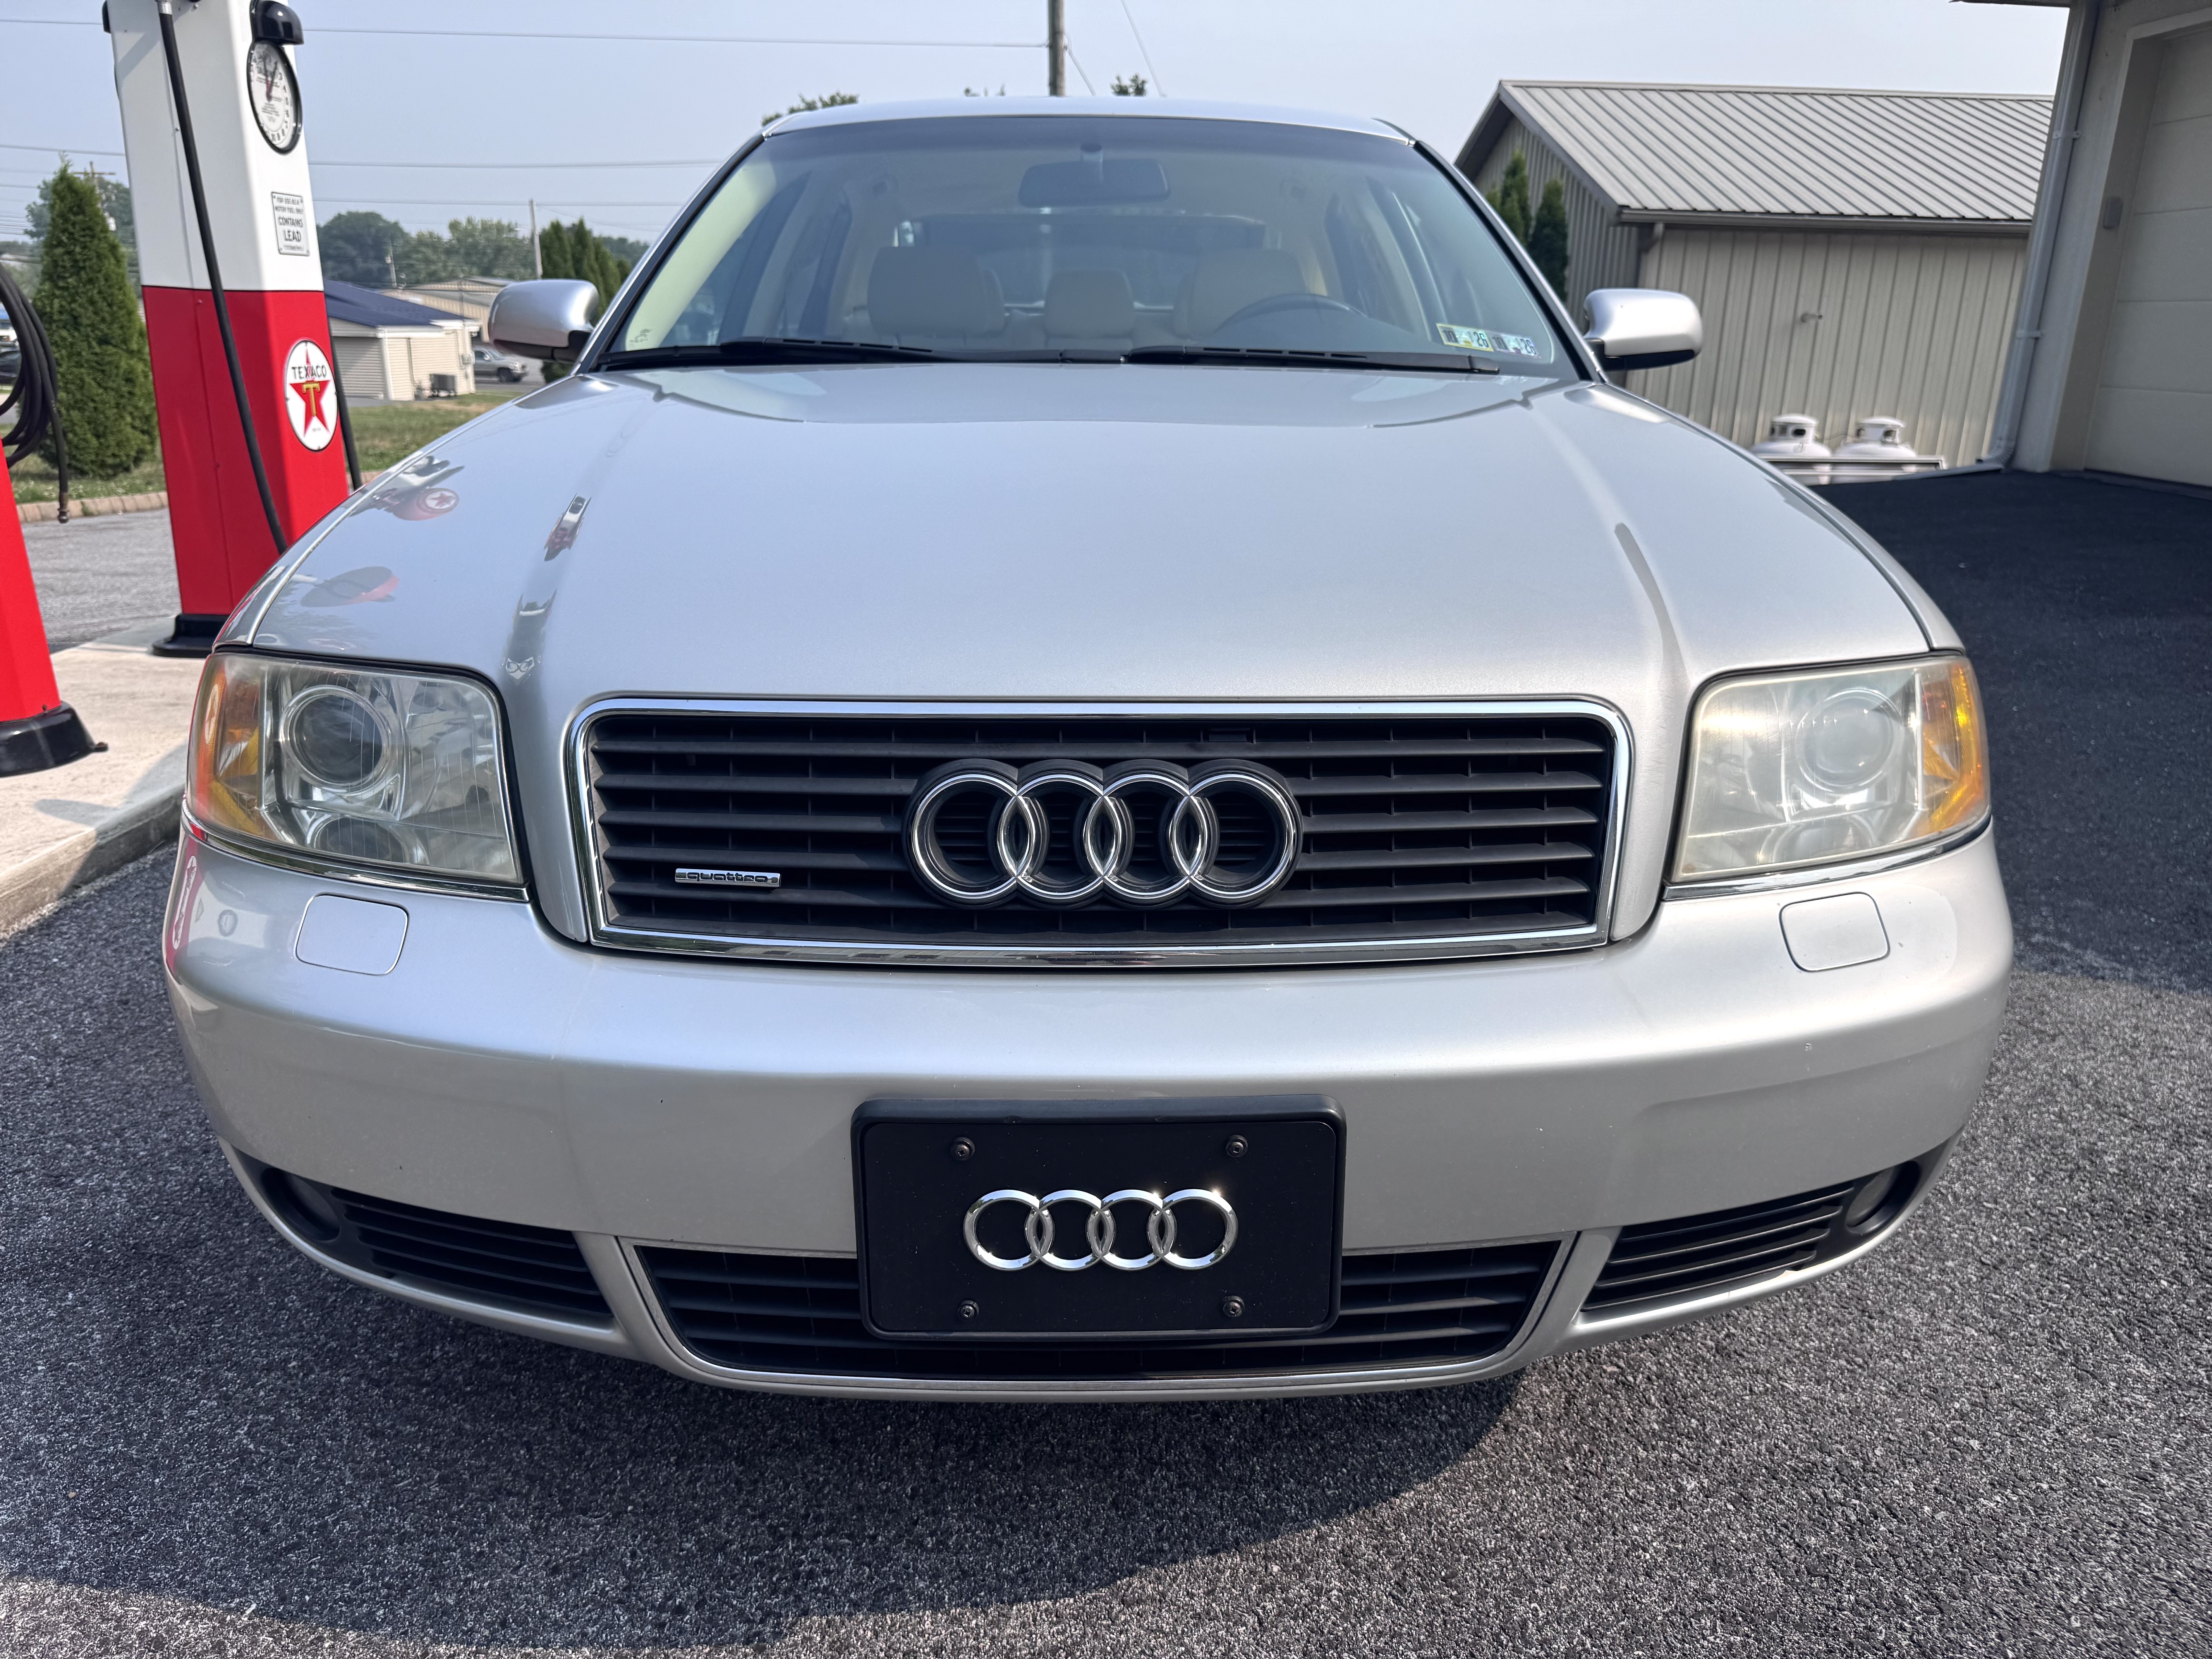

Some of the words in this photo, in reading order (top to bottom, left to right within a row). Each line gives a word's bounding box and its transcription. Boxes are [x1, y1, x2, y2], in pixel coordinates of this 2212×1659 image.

[278, 216, 304, 228] CONTAINS
[284, 229, 302, 242] LEAD
[1443, 330, 1459, 343] 10
[1473, 331, 1489, 348] 26
[1520, 338, 1537, 355] 26
[292, 364, 327, 380] TEXACO
[686, 872, 768, 883] quattro
